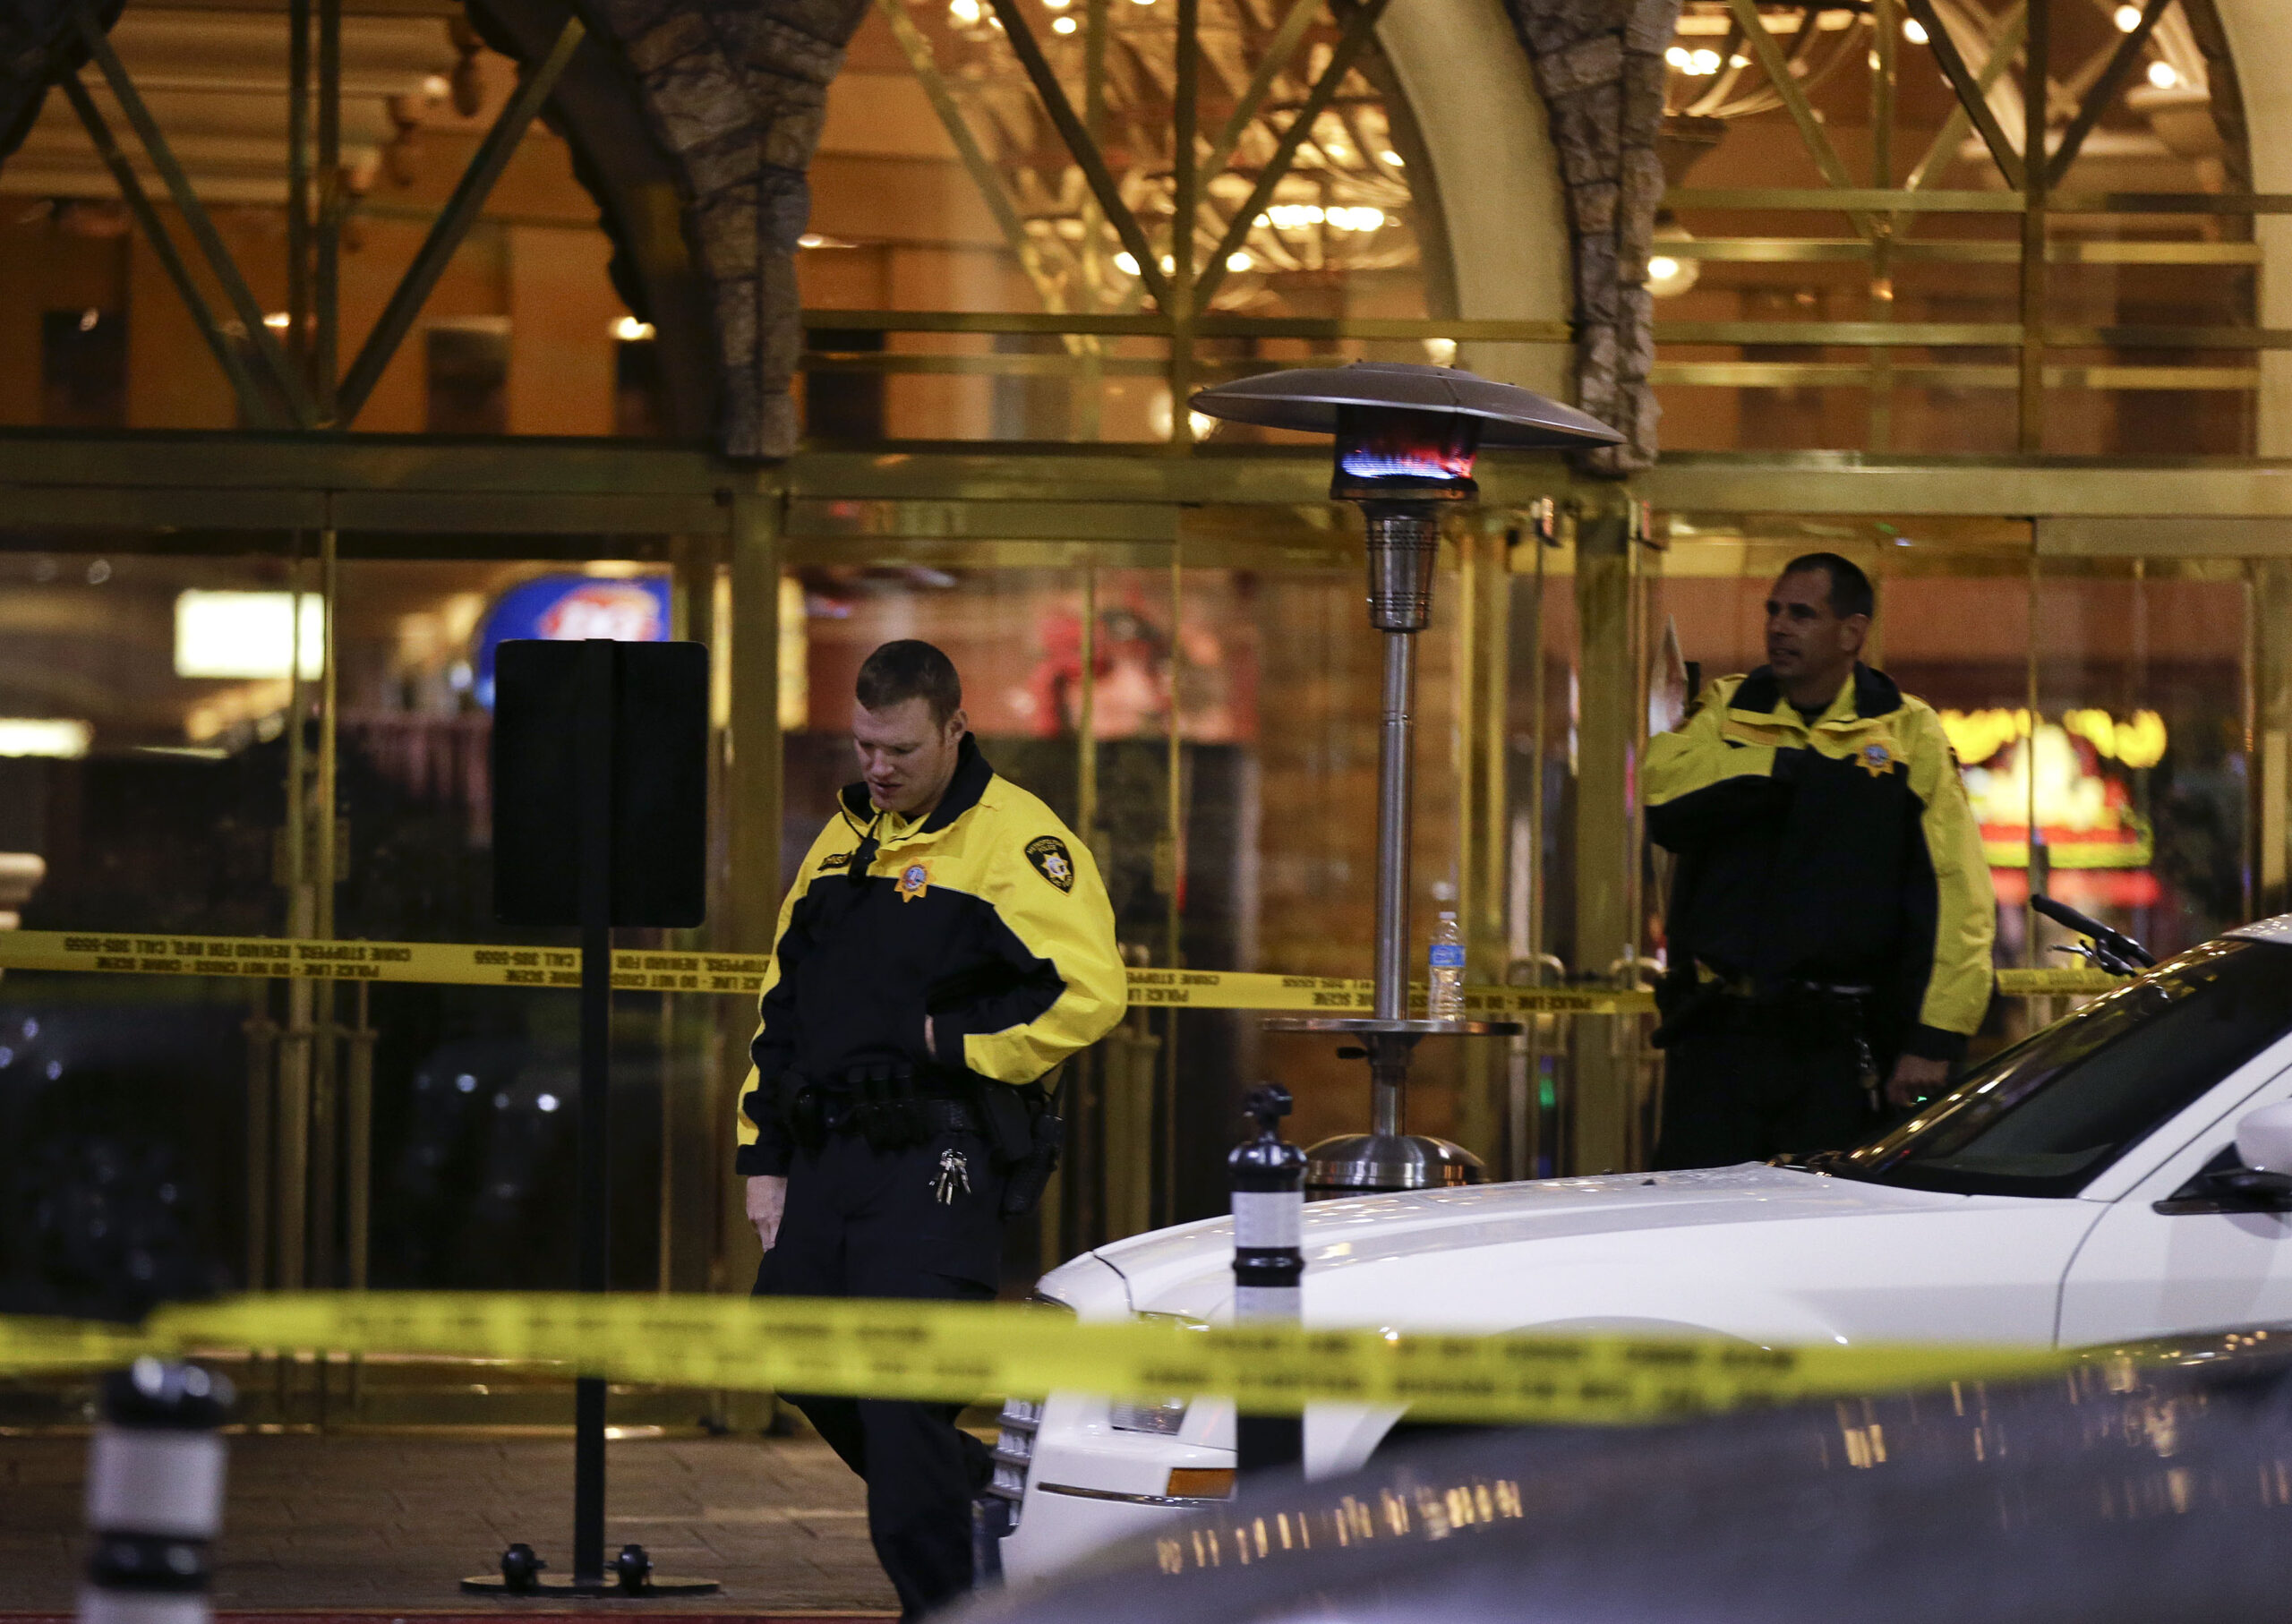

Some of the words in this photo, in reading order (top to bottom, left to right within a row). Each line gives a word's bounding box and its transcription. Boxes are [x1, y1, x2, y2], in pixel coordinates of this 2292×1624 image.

[136, 939, 167, 954] CALL
[207, 943, 234, 956] FOR
[235, 944, 291, 958] REWARD
[370, 947, 411, 962] CRIME
[545, 953, 576, 967] CALL
[97, 956, 135, 970] SCENE
[141, 958, 182, 971] CRIME
[194, 960, 239, 973] CROSS
[243, 962, 269, 974] NOT
[271, 962, 290, 975] DO
[616, 955, 640, 969] FOR
[644, 956, 698, 970] REWARD
[304, 964, 331, 976] LINE
[336, 964, 381, 978] POLICE
[505, 970, 544, 982] SCENE
[652, 974, 675, 987] NOT
[680, 975, 698, 987] DO
[711, 976, 739, 988] LINE
[1180, 973, 1220, 986] CRIME
[1145, 988, 1189, 1002] POLICE
[1465, 996, 1482, 1009] NO
[1518, 996, 1544, 1009] LINE
[1549, 996, 1592, 1010] POLICE
